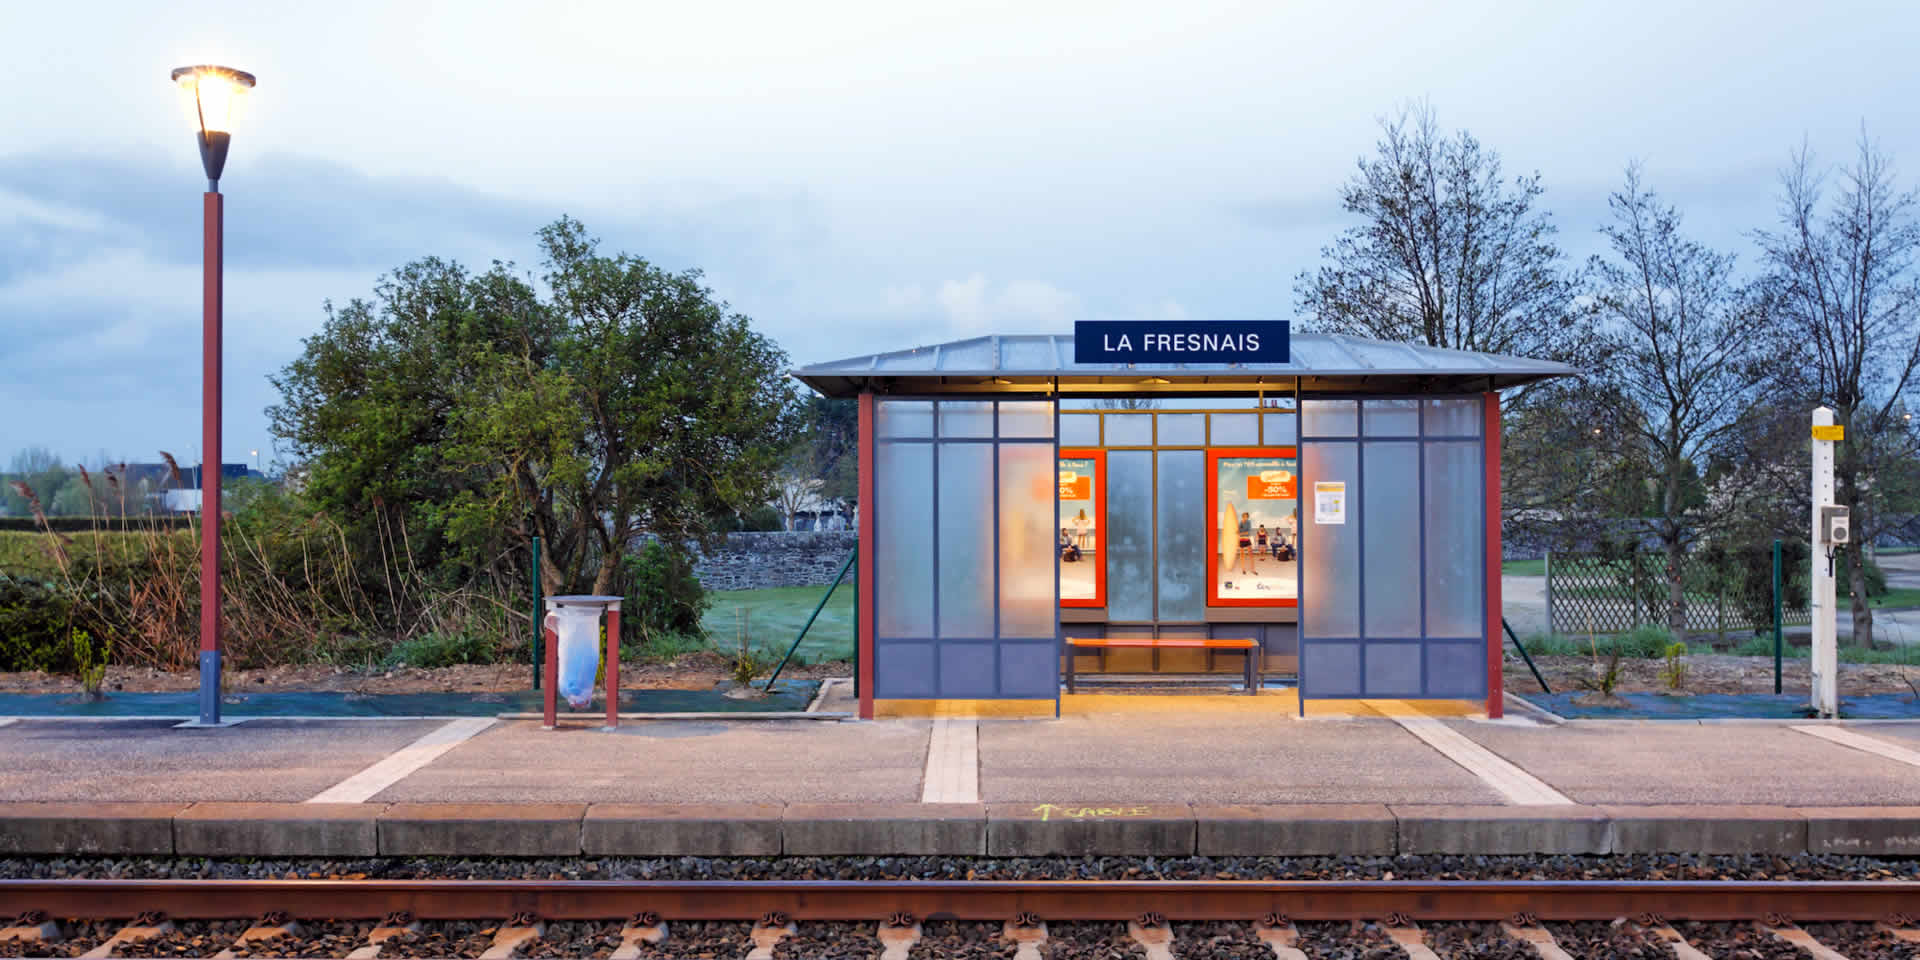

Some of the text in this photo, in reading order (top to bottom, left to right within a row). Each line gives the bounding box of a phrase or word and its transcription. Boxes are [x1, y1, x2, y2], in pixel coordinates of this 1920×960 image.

[1104, 334, 1260, 351] LA FRESNAIS
[1064, 805, 1151, 817] CABLE
